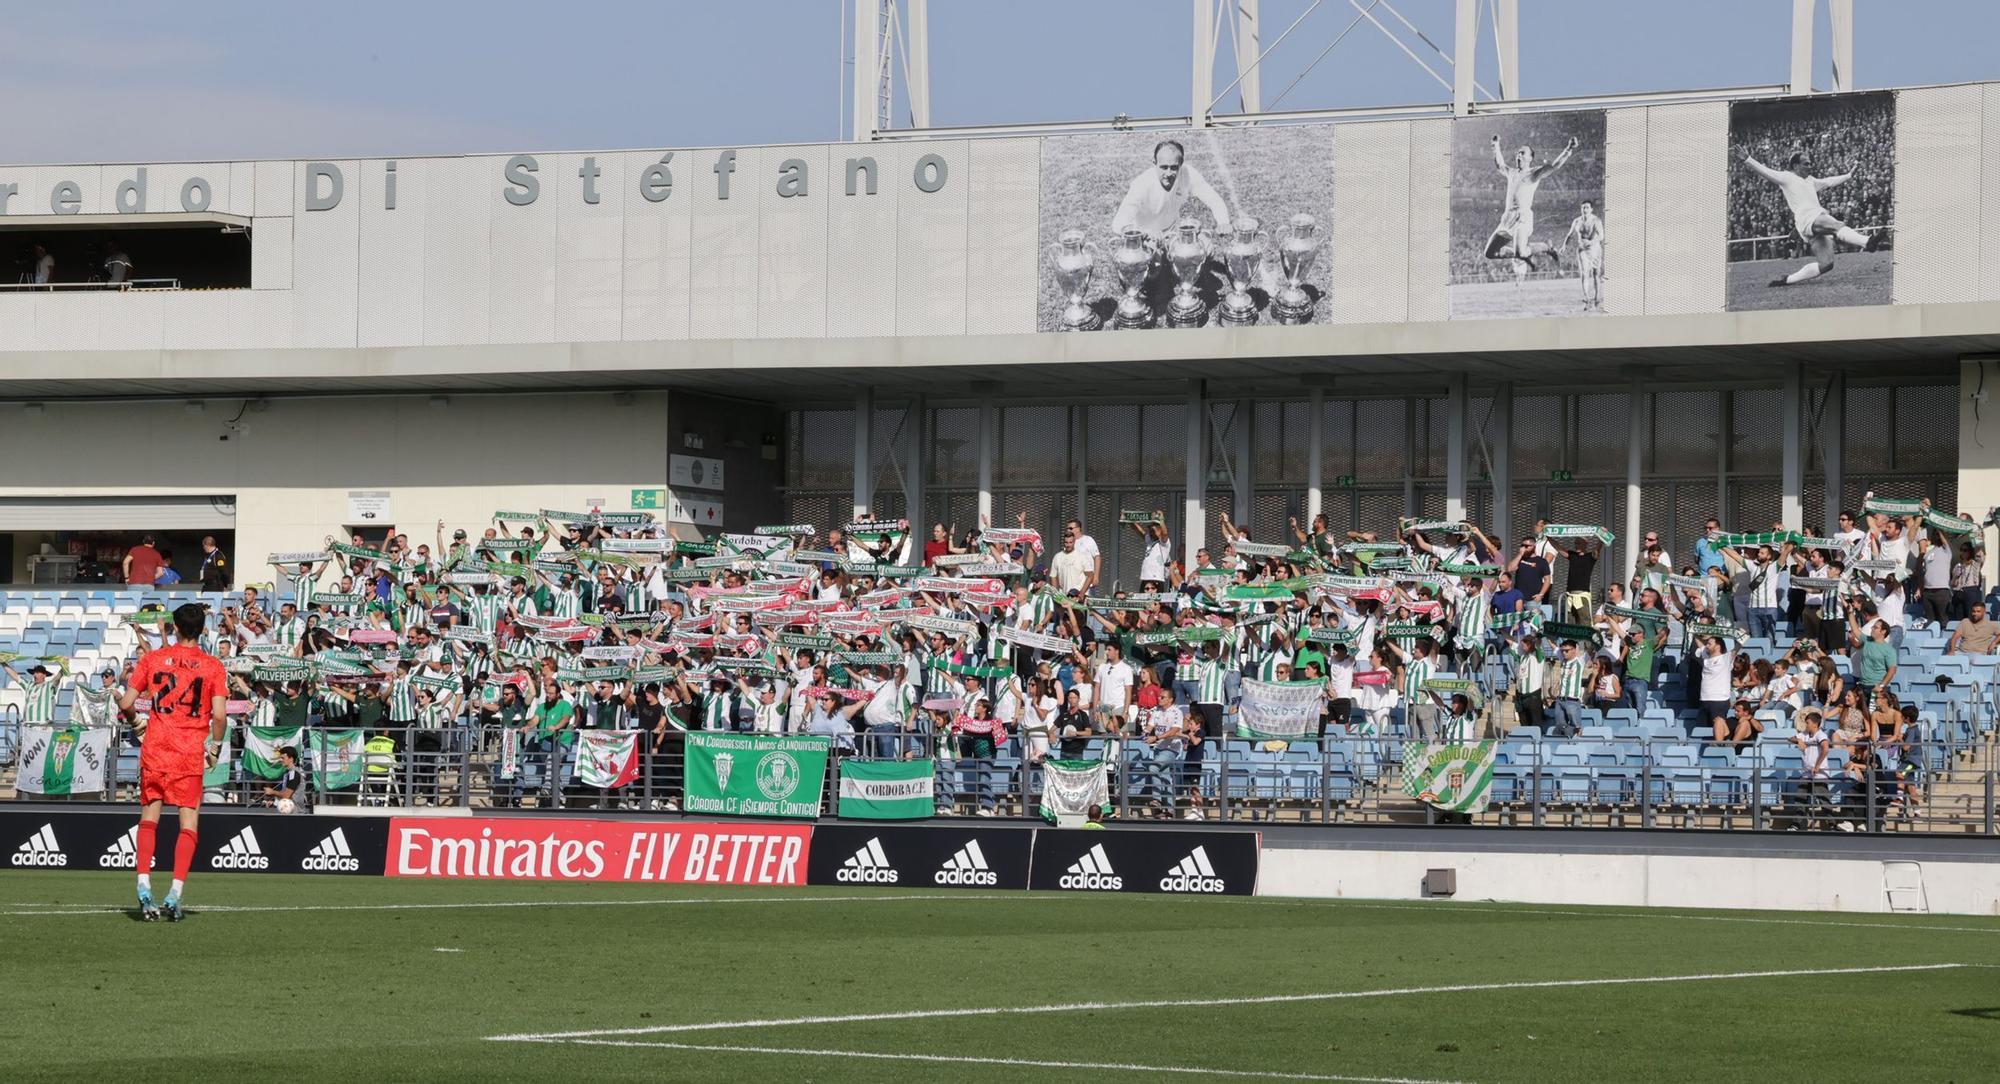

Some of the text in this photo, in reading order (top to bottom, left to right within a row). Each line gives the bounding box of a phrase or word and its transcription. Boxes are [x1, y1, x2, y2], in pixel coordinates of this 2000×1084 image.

[305, 162, 397, 212] Di
[503, 150, 949, 206] Stéfano
[1388, 626, 1421, 635] CÓRDOBA
[784, 635, 829, 646] CÓRDOBA CF
[254, 668, 309, 681] VOLVEREMOS
[152, 671, 204, 719] 24
[777, 739, 828, 752] BLANQUIVERDES
[78, 742, 100, 771] 1960
[687, 794, 725, 812] CÓRDOBA
[726, 797, 738, 812] CF
[11, 850, 67, 867] adidas
[99, 850, 156, 869] adids
[211, 852, 269, 870] adidas
[301, 854, 359, 871] adidas
[398, 827, 803, 884] Emirates FLY BETTER
[836, 866, 898, 883] adidas
[934, 868, 997, 885] adidas
[1059, 872, 1123, 890] adidas
[1159, 874, 1225, 893] adidas
